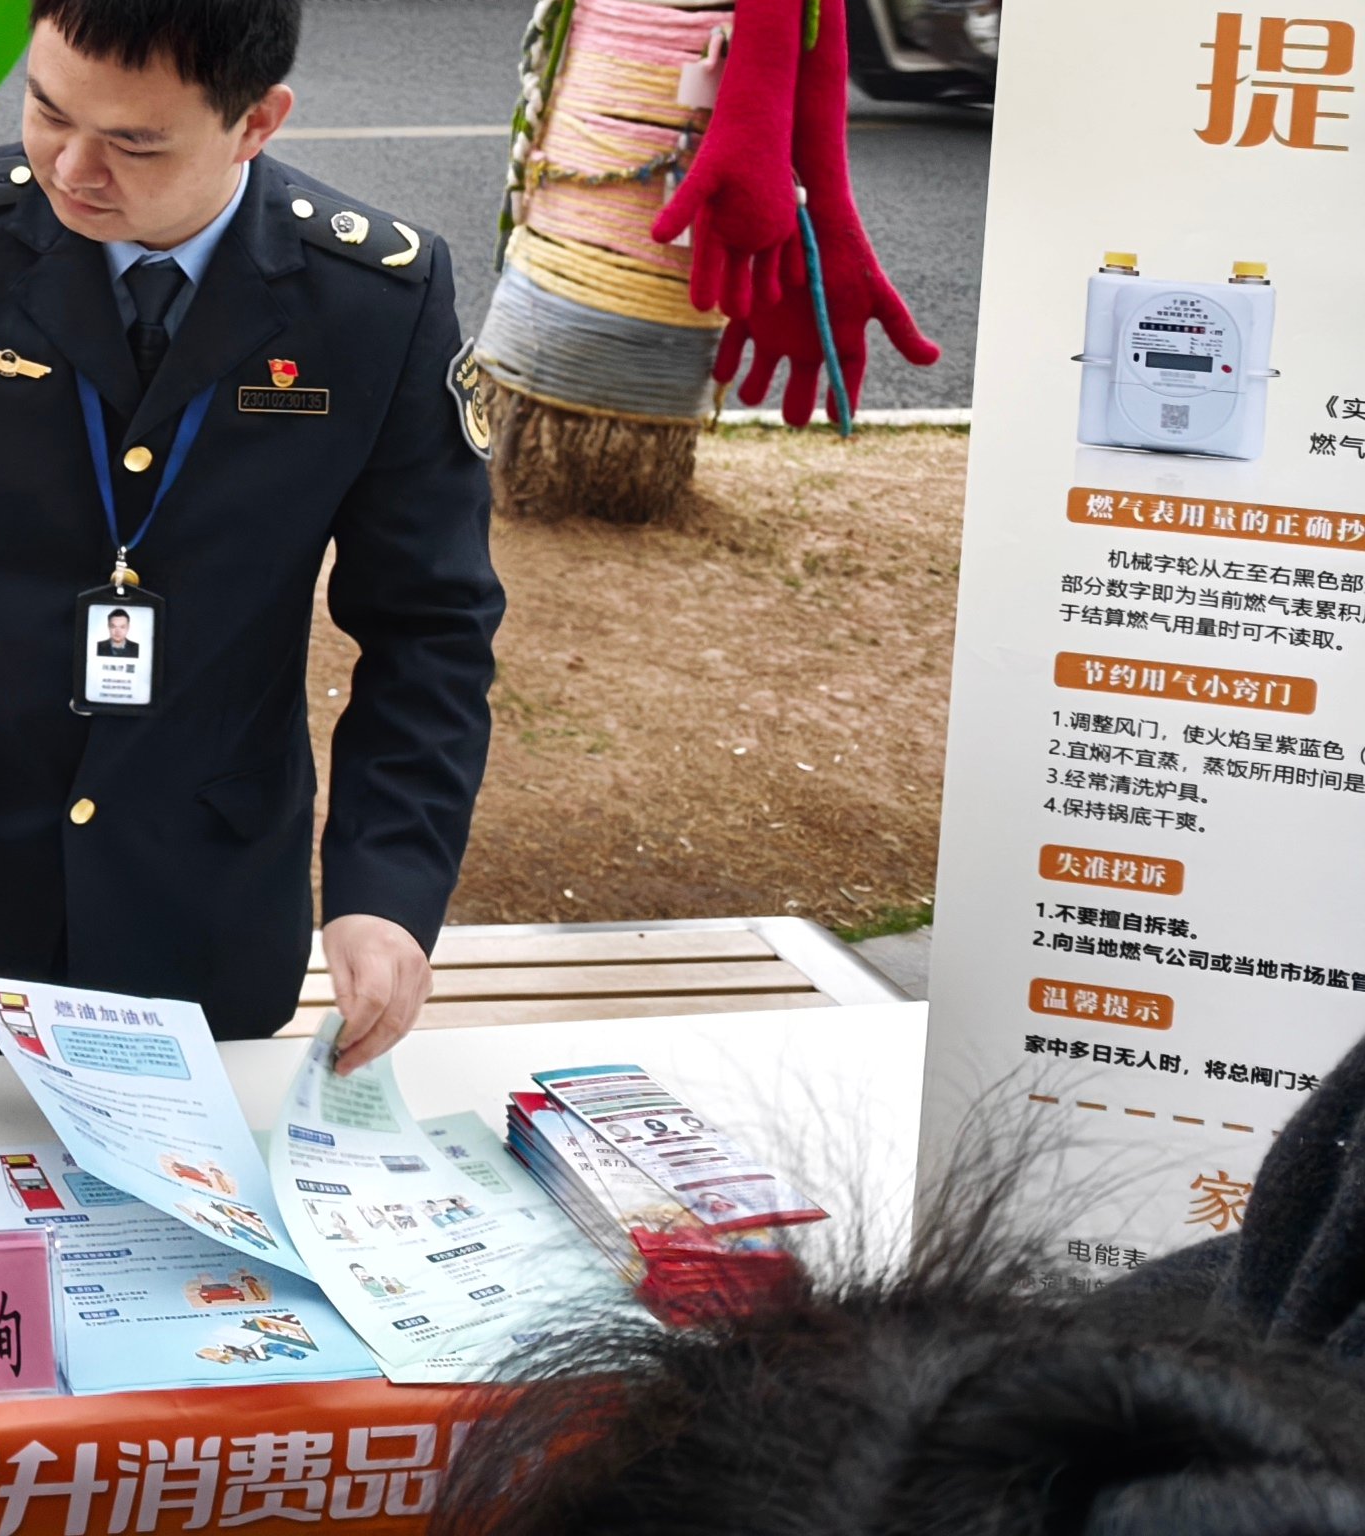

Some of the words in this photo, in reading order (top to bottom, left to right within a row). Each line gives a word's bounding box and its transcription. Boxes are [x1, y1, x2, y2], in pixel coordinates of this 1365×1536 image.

[1193, 11, 1355, 152] 提
[1309, 432, 1365, 459] 燃气
[1108, 549, 1365, 594] 机械字轮从左至右黑色部
[1061, 574, 1365, 624] 部分数字即为当前燃气表累积
[1059, 603, 1346, 651] 于结算燃气用量时可不读取。
[1080, 659, 1292, 706] 节约用气小窍门
[1046, 768, 1209, 804] 3.经常清洗炉具。
[1043, 797, 1206, 833] 4.保持锅底干爽。
[1056, 851, 1167, 888] 失准投诉
[1035, 902, 1199, 940] 1.不要擅自拆装。
[54, 999, 164, 1027] 燃油加油机
[1042, 984, 1160, 1022] 温馨提示
[1185, 1170, 1253, 1232] 家
[1068, 1240, 1149, 1270] 电能表
